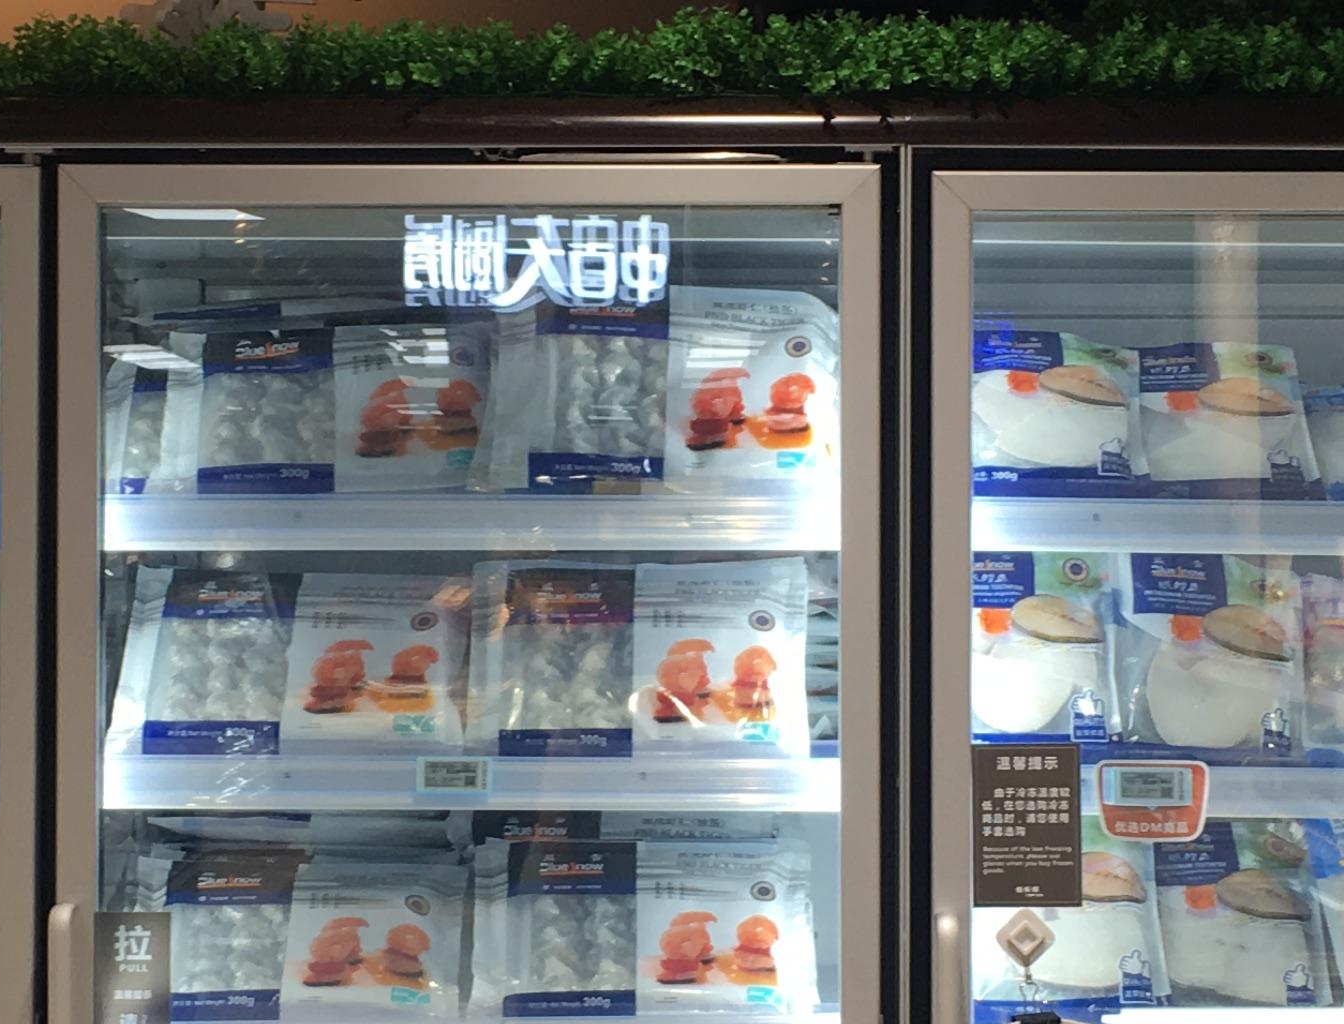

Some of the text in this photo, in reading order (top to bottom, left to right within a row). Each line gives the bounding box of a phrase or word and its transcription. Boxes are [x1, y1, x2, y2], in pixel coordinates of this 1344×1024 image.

[279, 468, 310, 480] 300g
[996, 756, 1059, 771] 温馨提示
[113, 925, 152, 961] 拉
[119, 964, 148, 973] PULL
